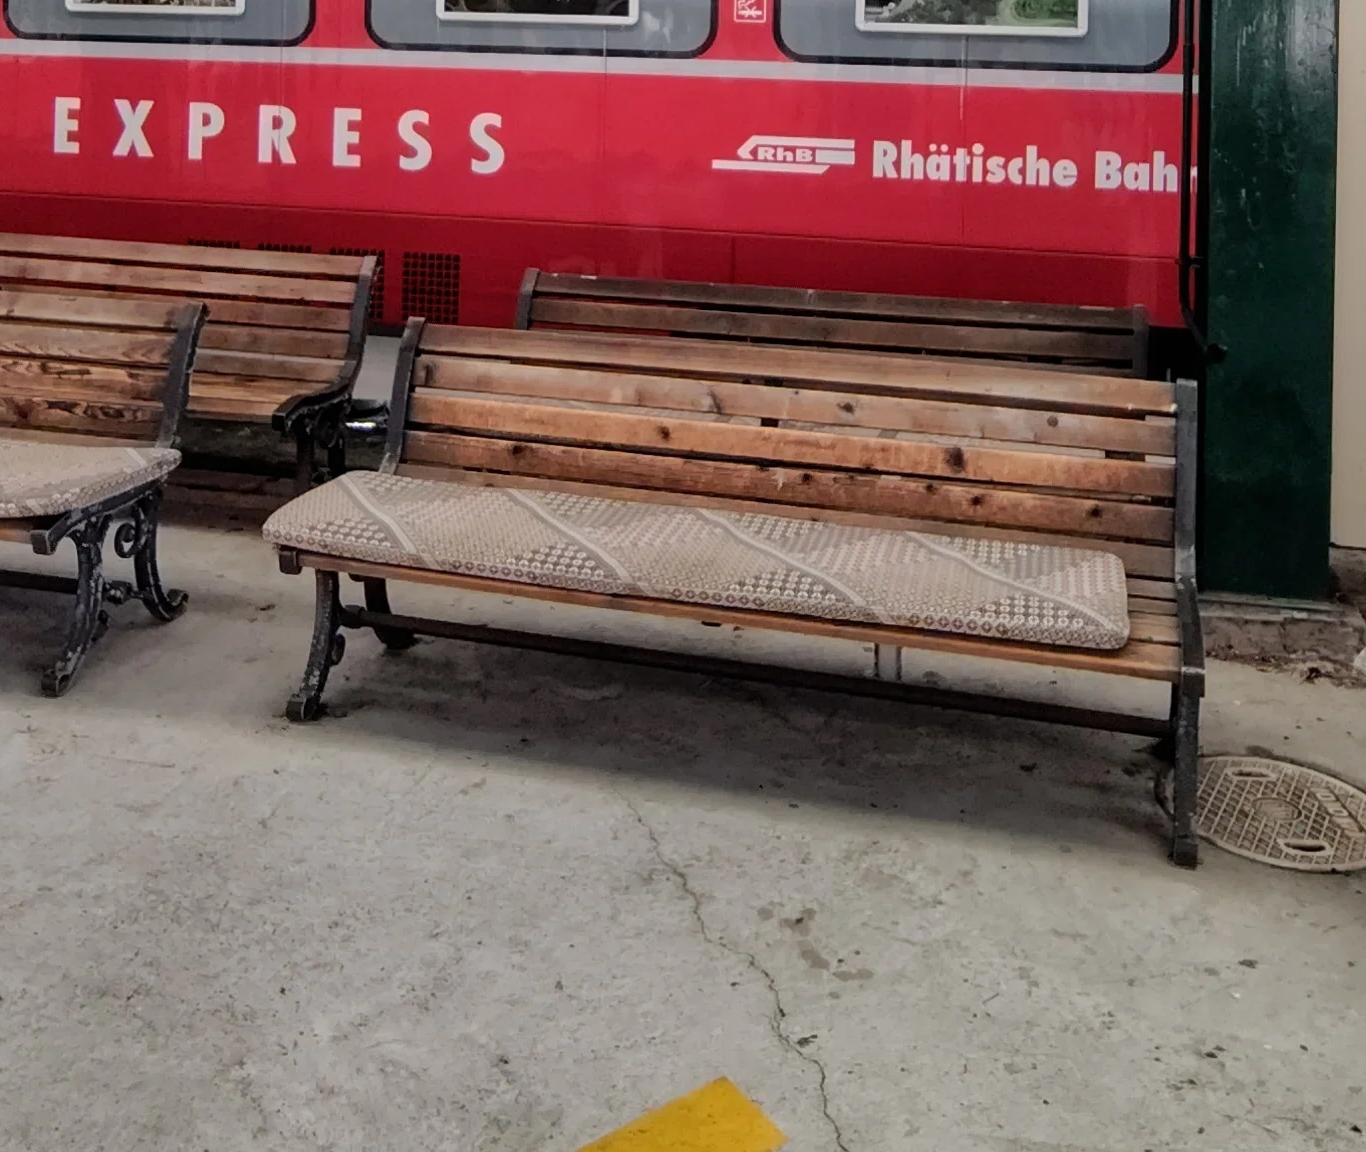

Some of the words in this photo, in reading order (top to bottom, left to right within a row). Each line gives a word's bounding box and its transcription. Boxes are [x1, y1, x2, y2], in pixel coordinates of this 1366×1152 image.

[53, 95, 506, 175] EXPRESS
[756, 146, 814, 163] RhB
[872, 139, 1078, 187] Rhätische
